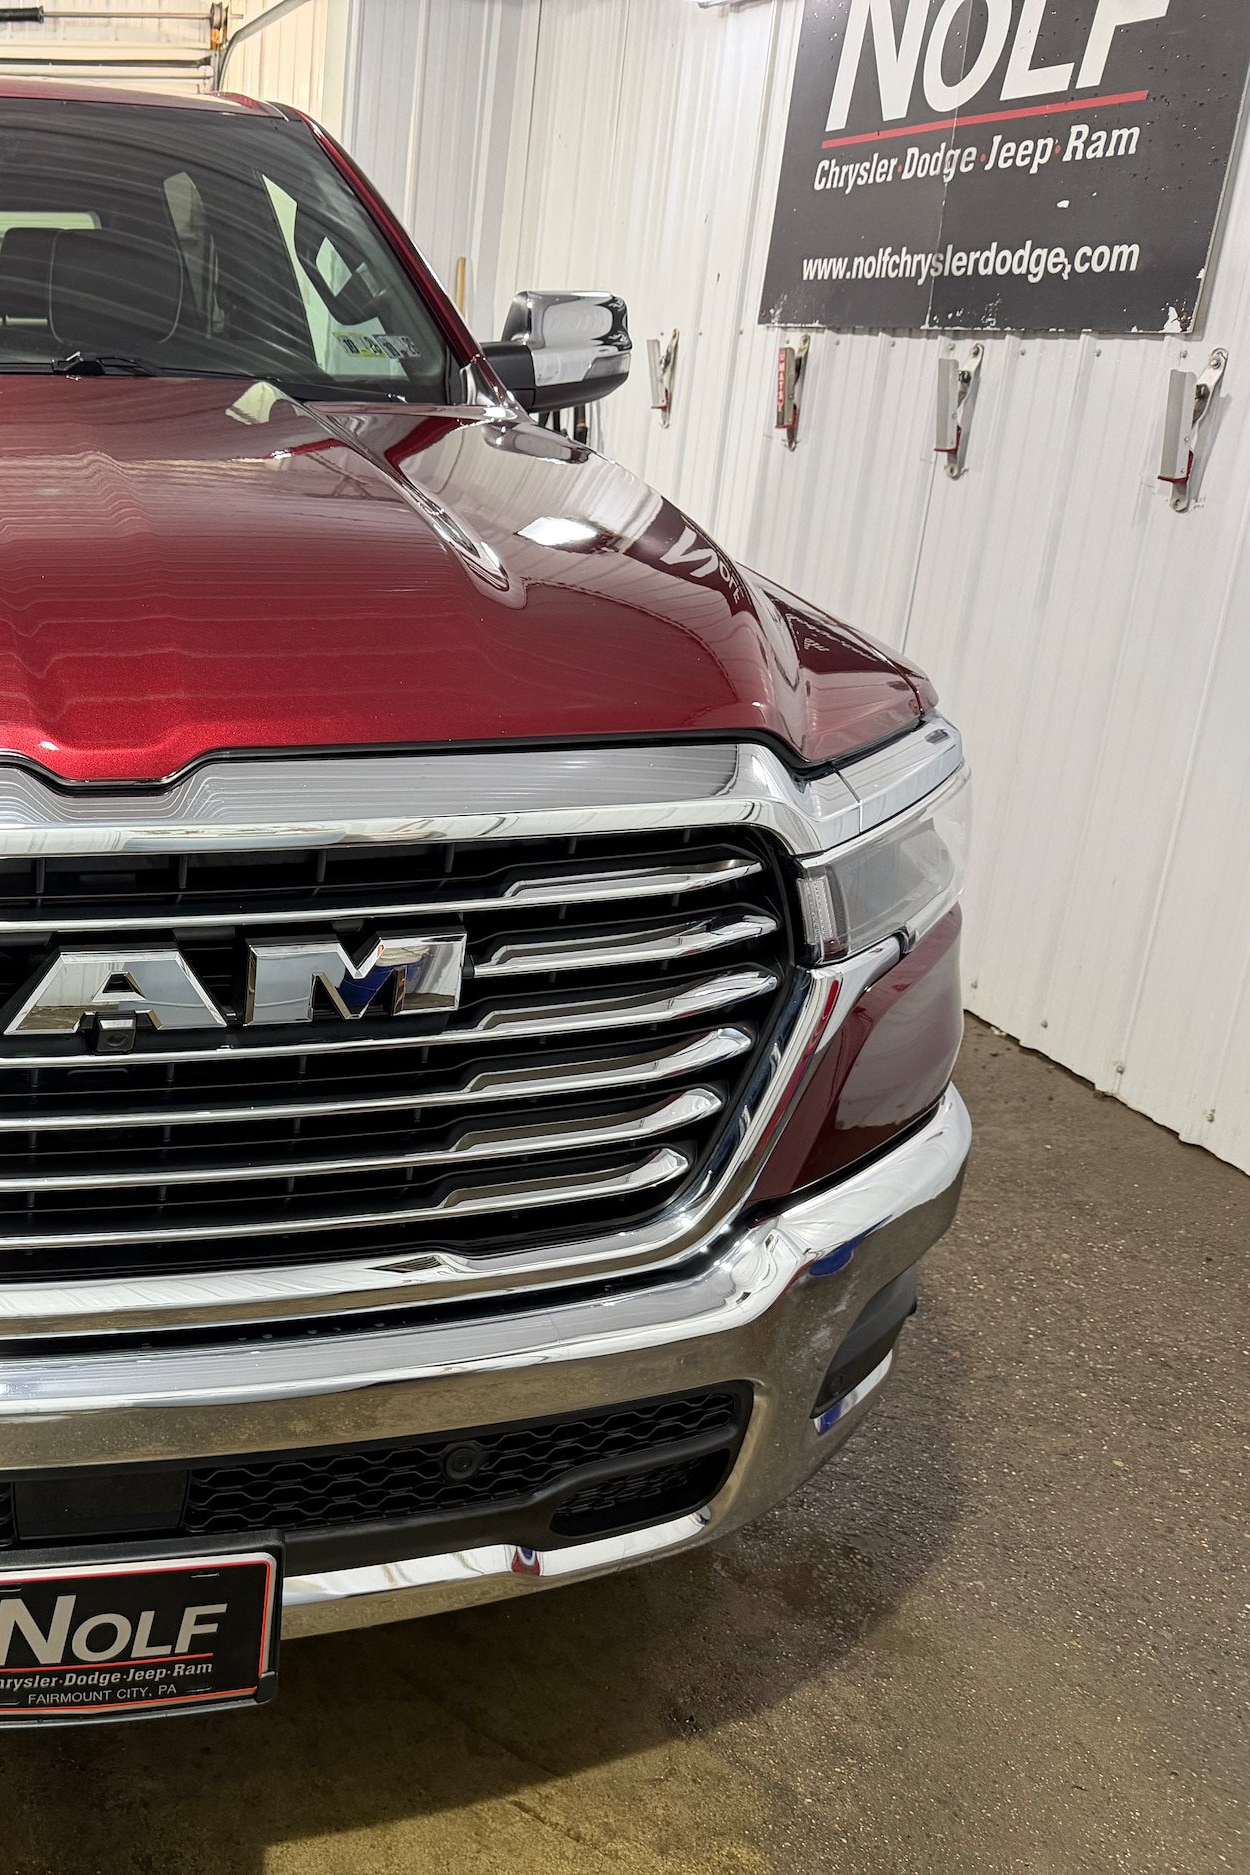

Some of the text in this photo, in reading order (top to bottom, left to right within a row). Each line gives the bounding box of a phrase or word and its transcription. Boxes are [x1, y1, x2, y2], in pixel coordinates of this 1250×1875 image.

[825, 0, 1169, 132] NOLF
[813, 124, 1140, 194] Chrysler Dodge Jeep Ram
[802, 241, 1140, 285] www.nolfchryslerdodge.com
[28, 1689, 112, 1705] FAIRMOUNT
[158, 1683, 177, 1695] PA
[64, 1671, 121, 1687] Dodge
[126, 1667, 166, 1680] Jeep
[173, 1663, 212, 1677] Ram
